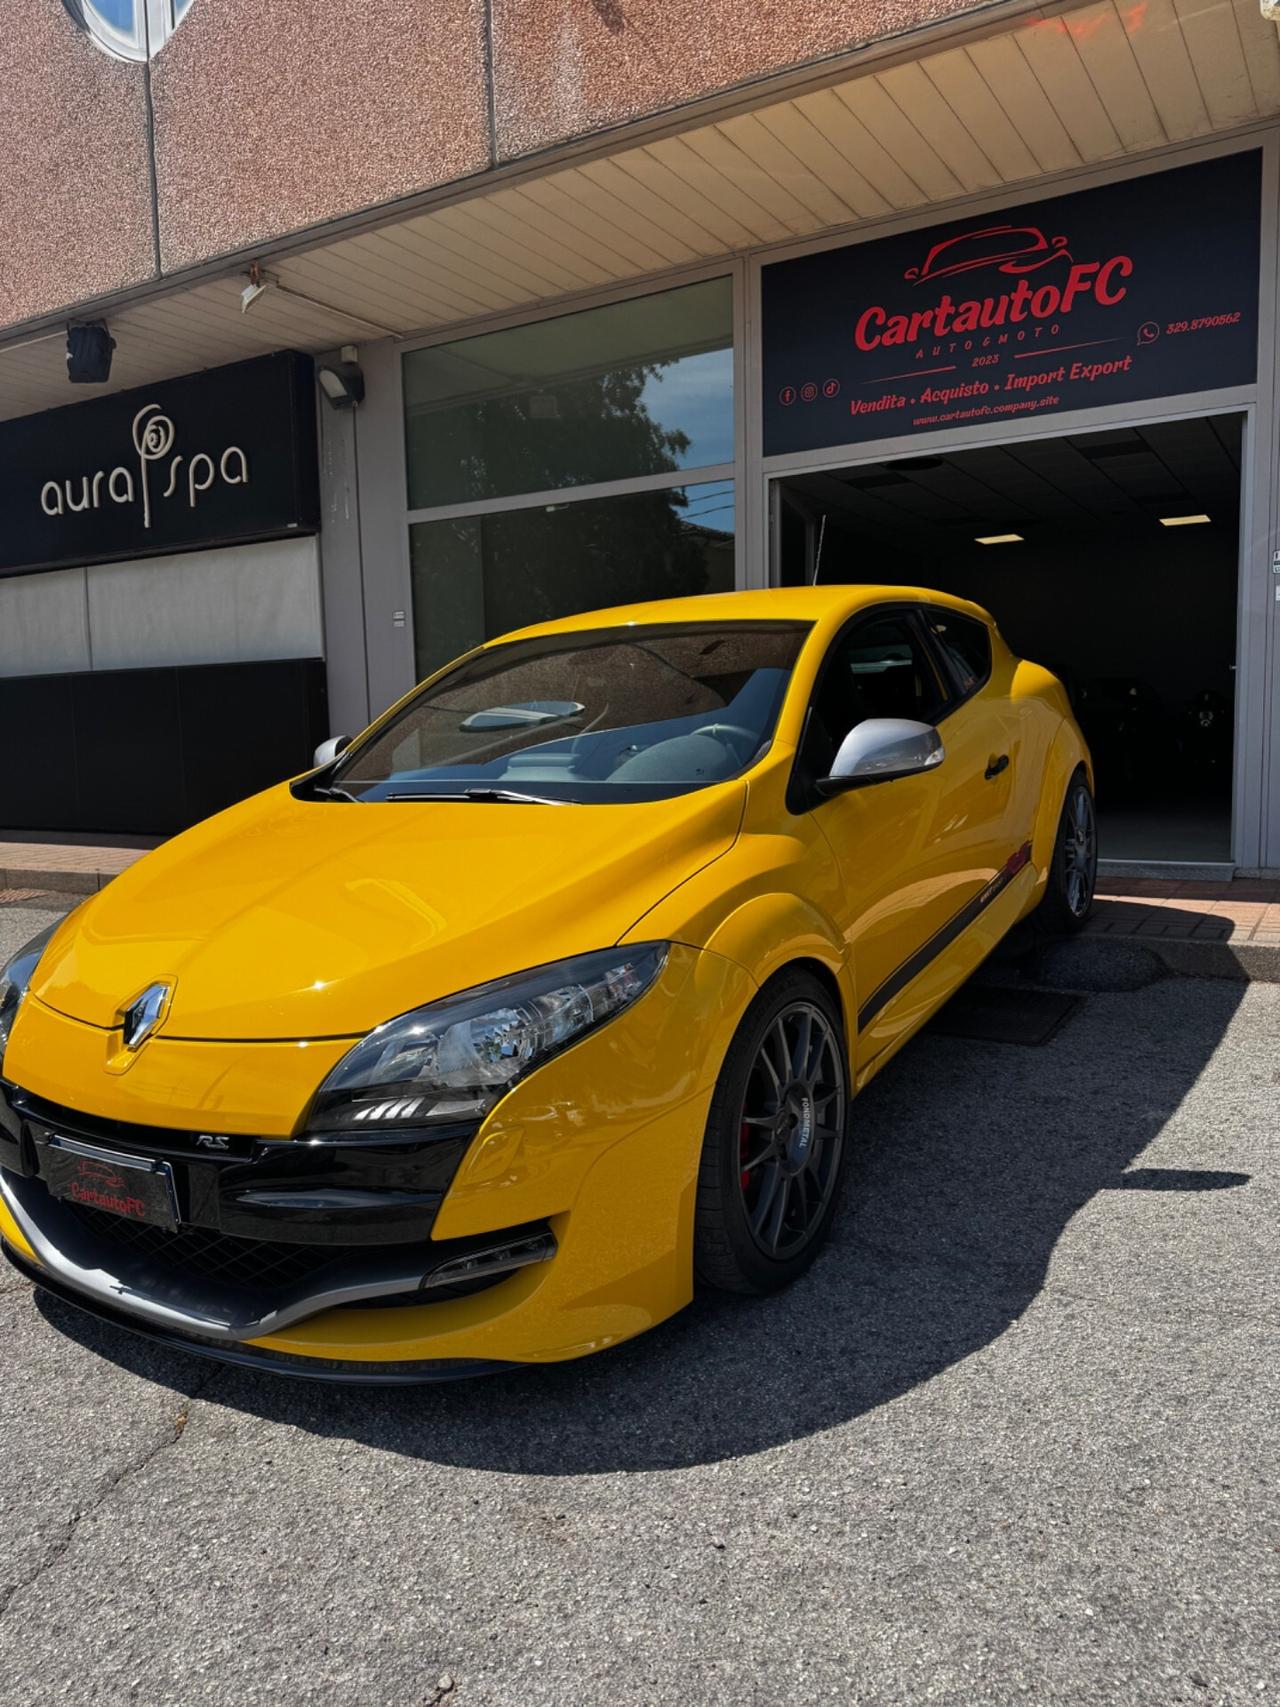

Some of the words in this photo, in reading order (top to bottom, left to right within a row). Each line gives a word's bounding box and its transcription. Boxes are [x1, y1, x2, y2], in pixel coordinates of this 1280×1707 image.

[853, 255, 1133, 351] CartautoFC
[1166, 312, 1241, 335] 329.8790562
[971, 353, 1000, 368] 2023
[850, 395, 906, 415] Vendita
[920, 381, 989, 404] Acquisto
[1004, 367, 1065, 392] Import
[1069, 355, 1132, 381] Export
[912, 395, 1060, 425] www.cartautofc.company.site
[41, 466, 134, 516] aura
[163, 446, 248, 507] spa
[799, 1097, 811, 1148] FONDMETAL
[197, 1135, 229, 1150] RS
[70, 1182, 145, 1217] CartautoFC
